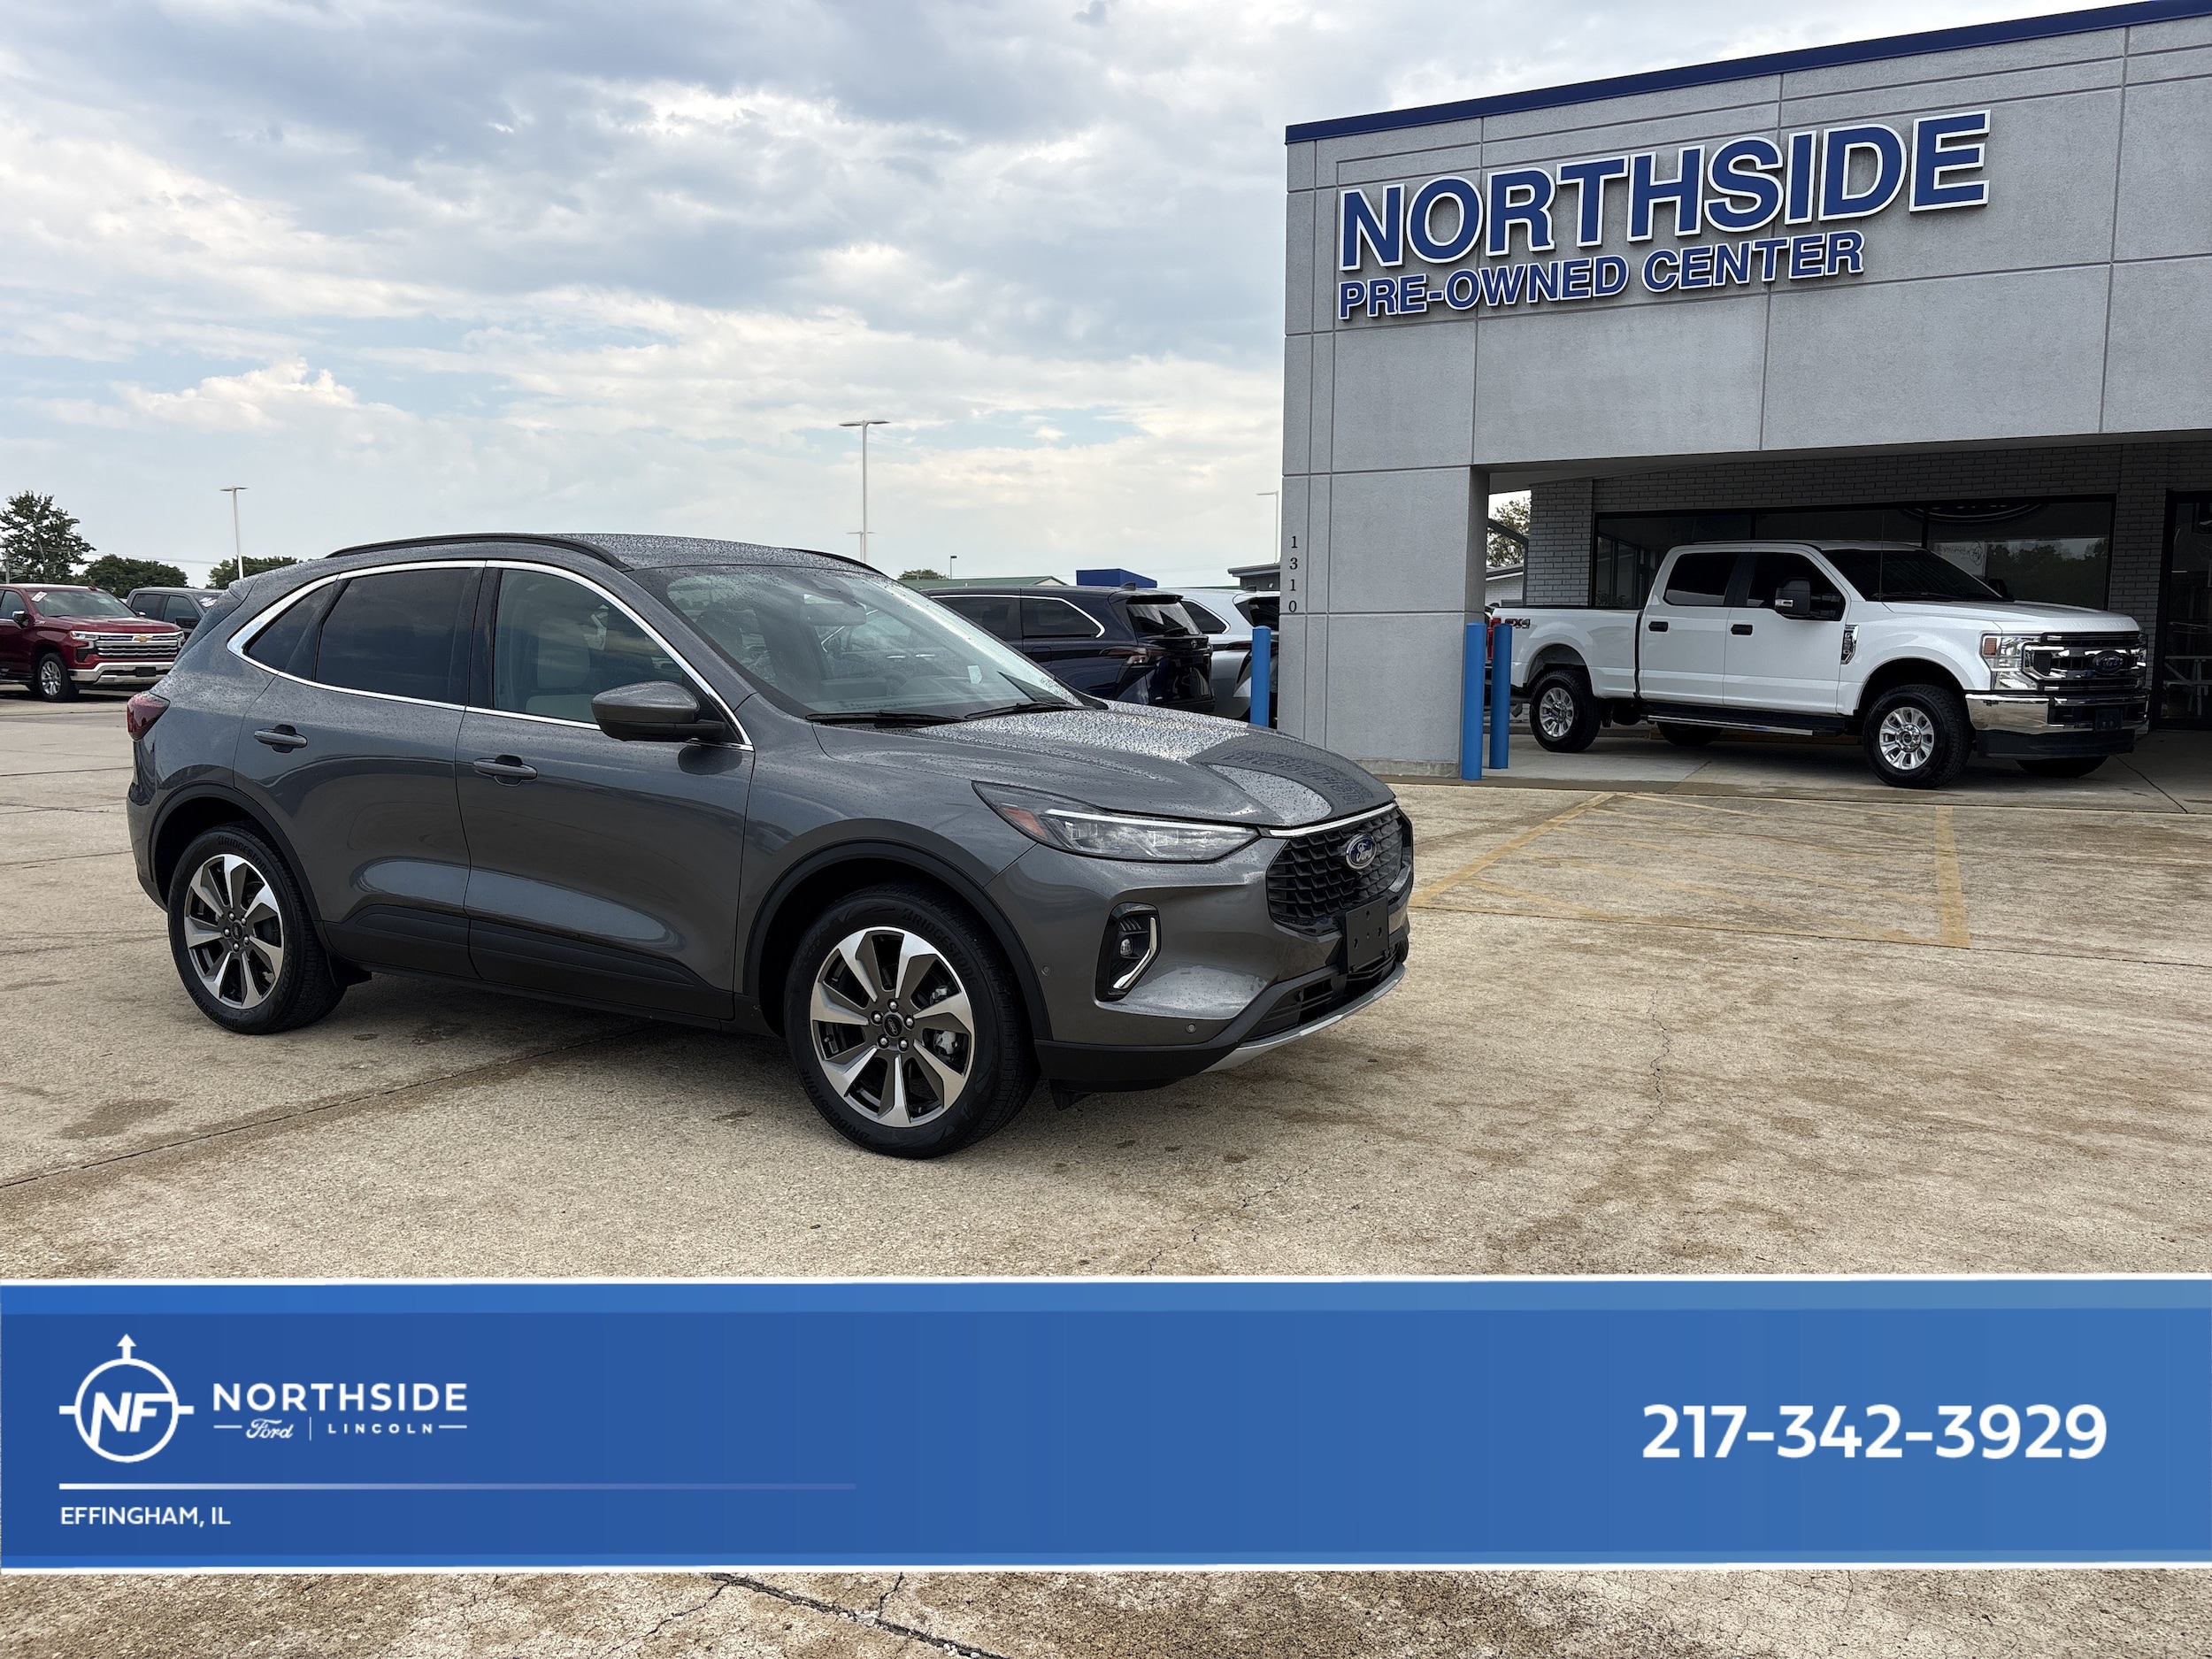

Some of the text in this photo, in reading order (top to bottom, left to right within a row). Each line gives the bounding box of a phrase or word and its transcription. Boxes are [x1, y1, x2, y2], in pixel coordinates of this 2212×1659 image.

[1339, 109, 1992, 272] NORTHSIDE
[1338, 229, 1865, 321] PRE-OWNED CENTER
[1288, 534, 1299, 613] 1310
[218, 834, 271, 876] BRIDGESTONE
[901, 907, 979, 987] BRIDGESTONE
[801, 1067, 871, 1145] BRIDGESTONE
